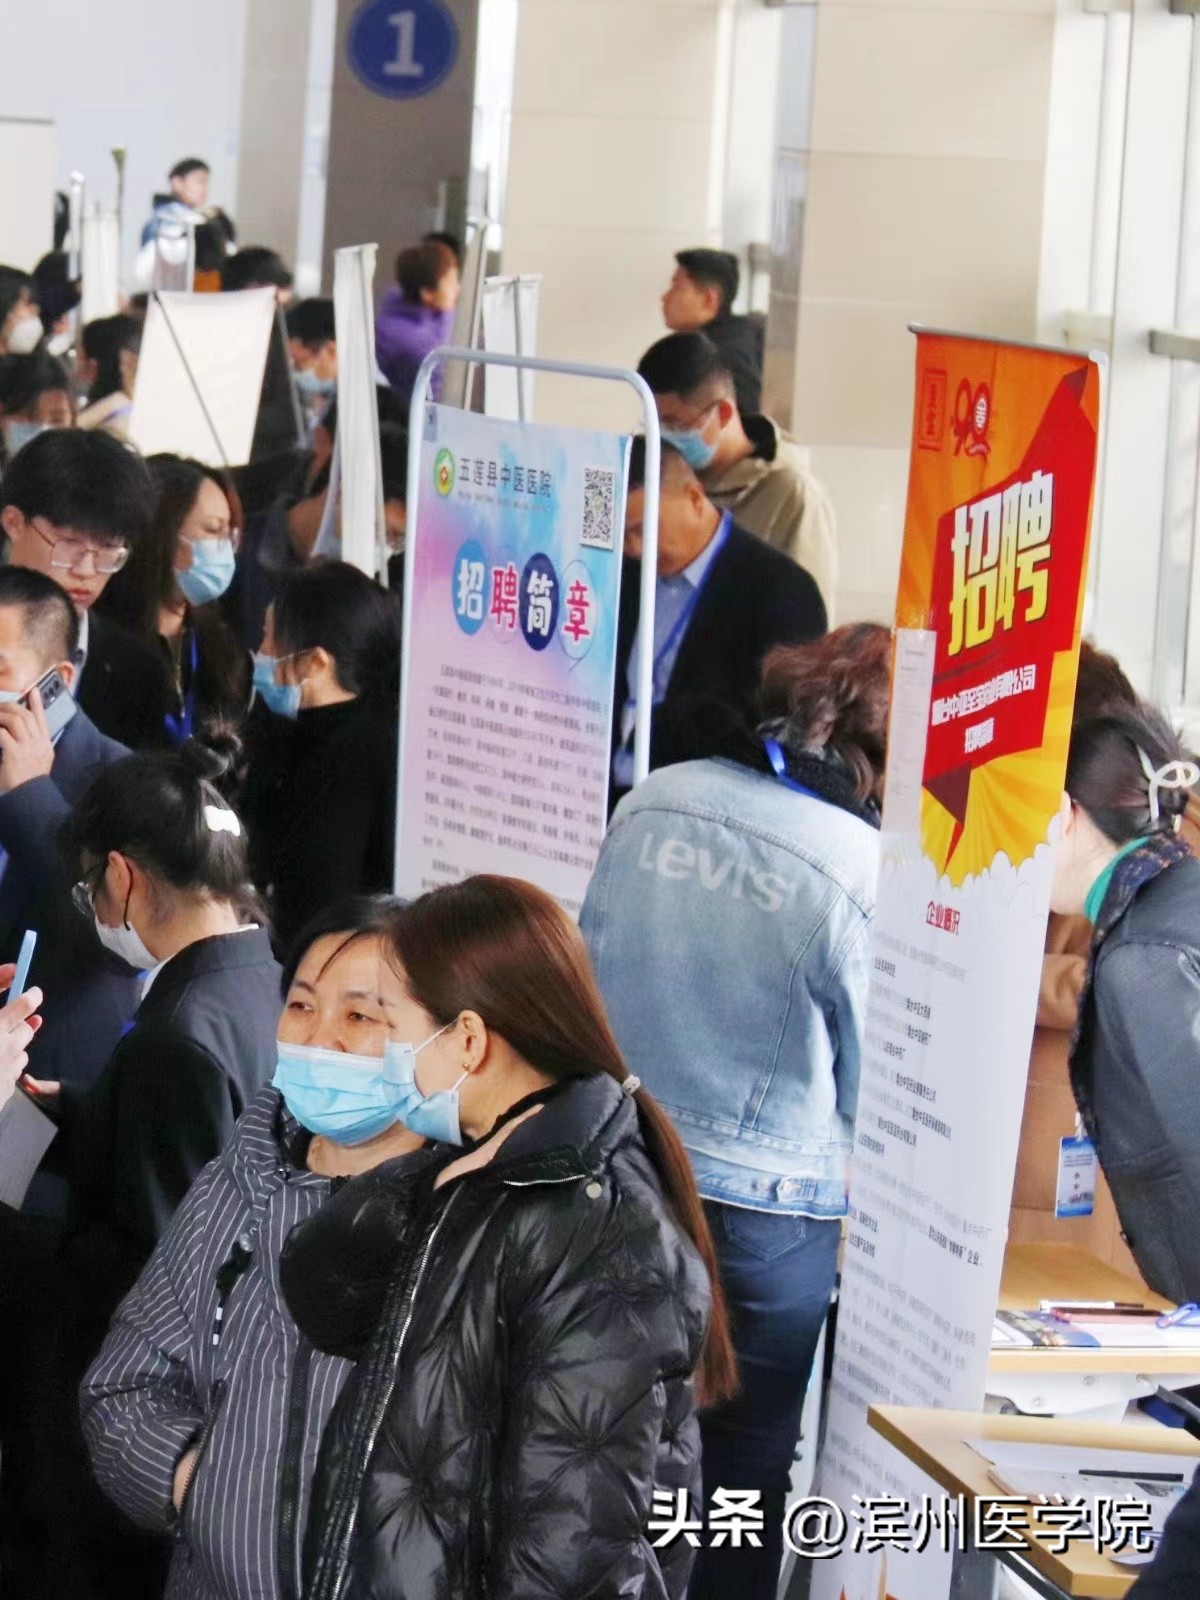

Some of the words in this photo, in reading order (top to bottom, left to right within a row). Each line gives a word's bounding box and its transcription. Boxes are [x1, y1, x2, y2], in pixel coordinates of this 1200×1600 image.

[382, 9, 425, 77] 1
[457, 558, 591, 643] 招聘简章
[948, 469, 1054, 657] 招聘
